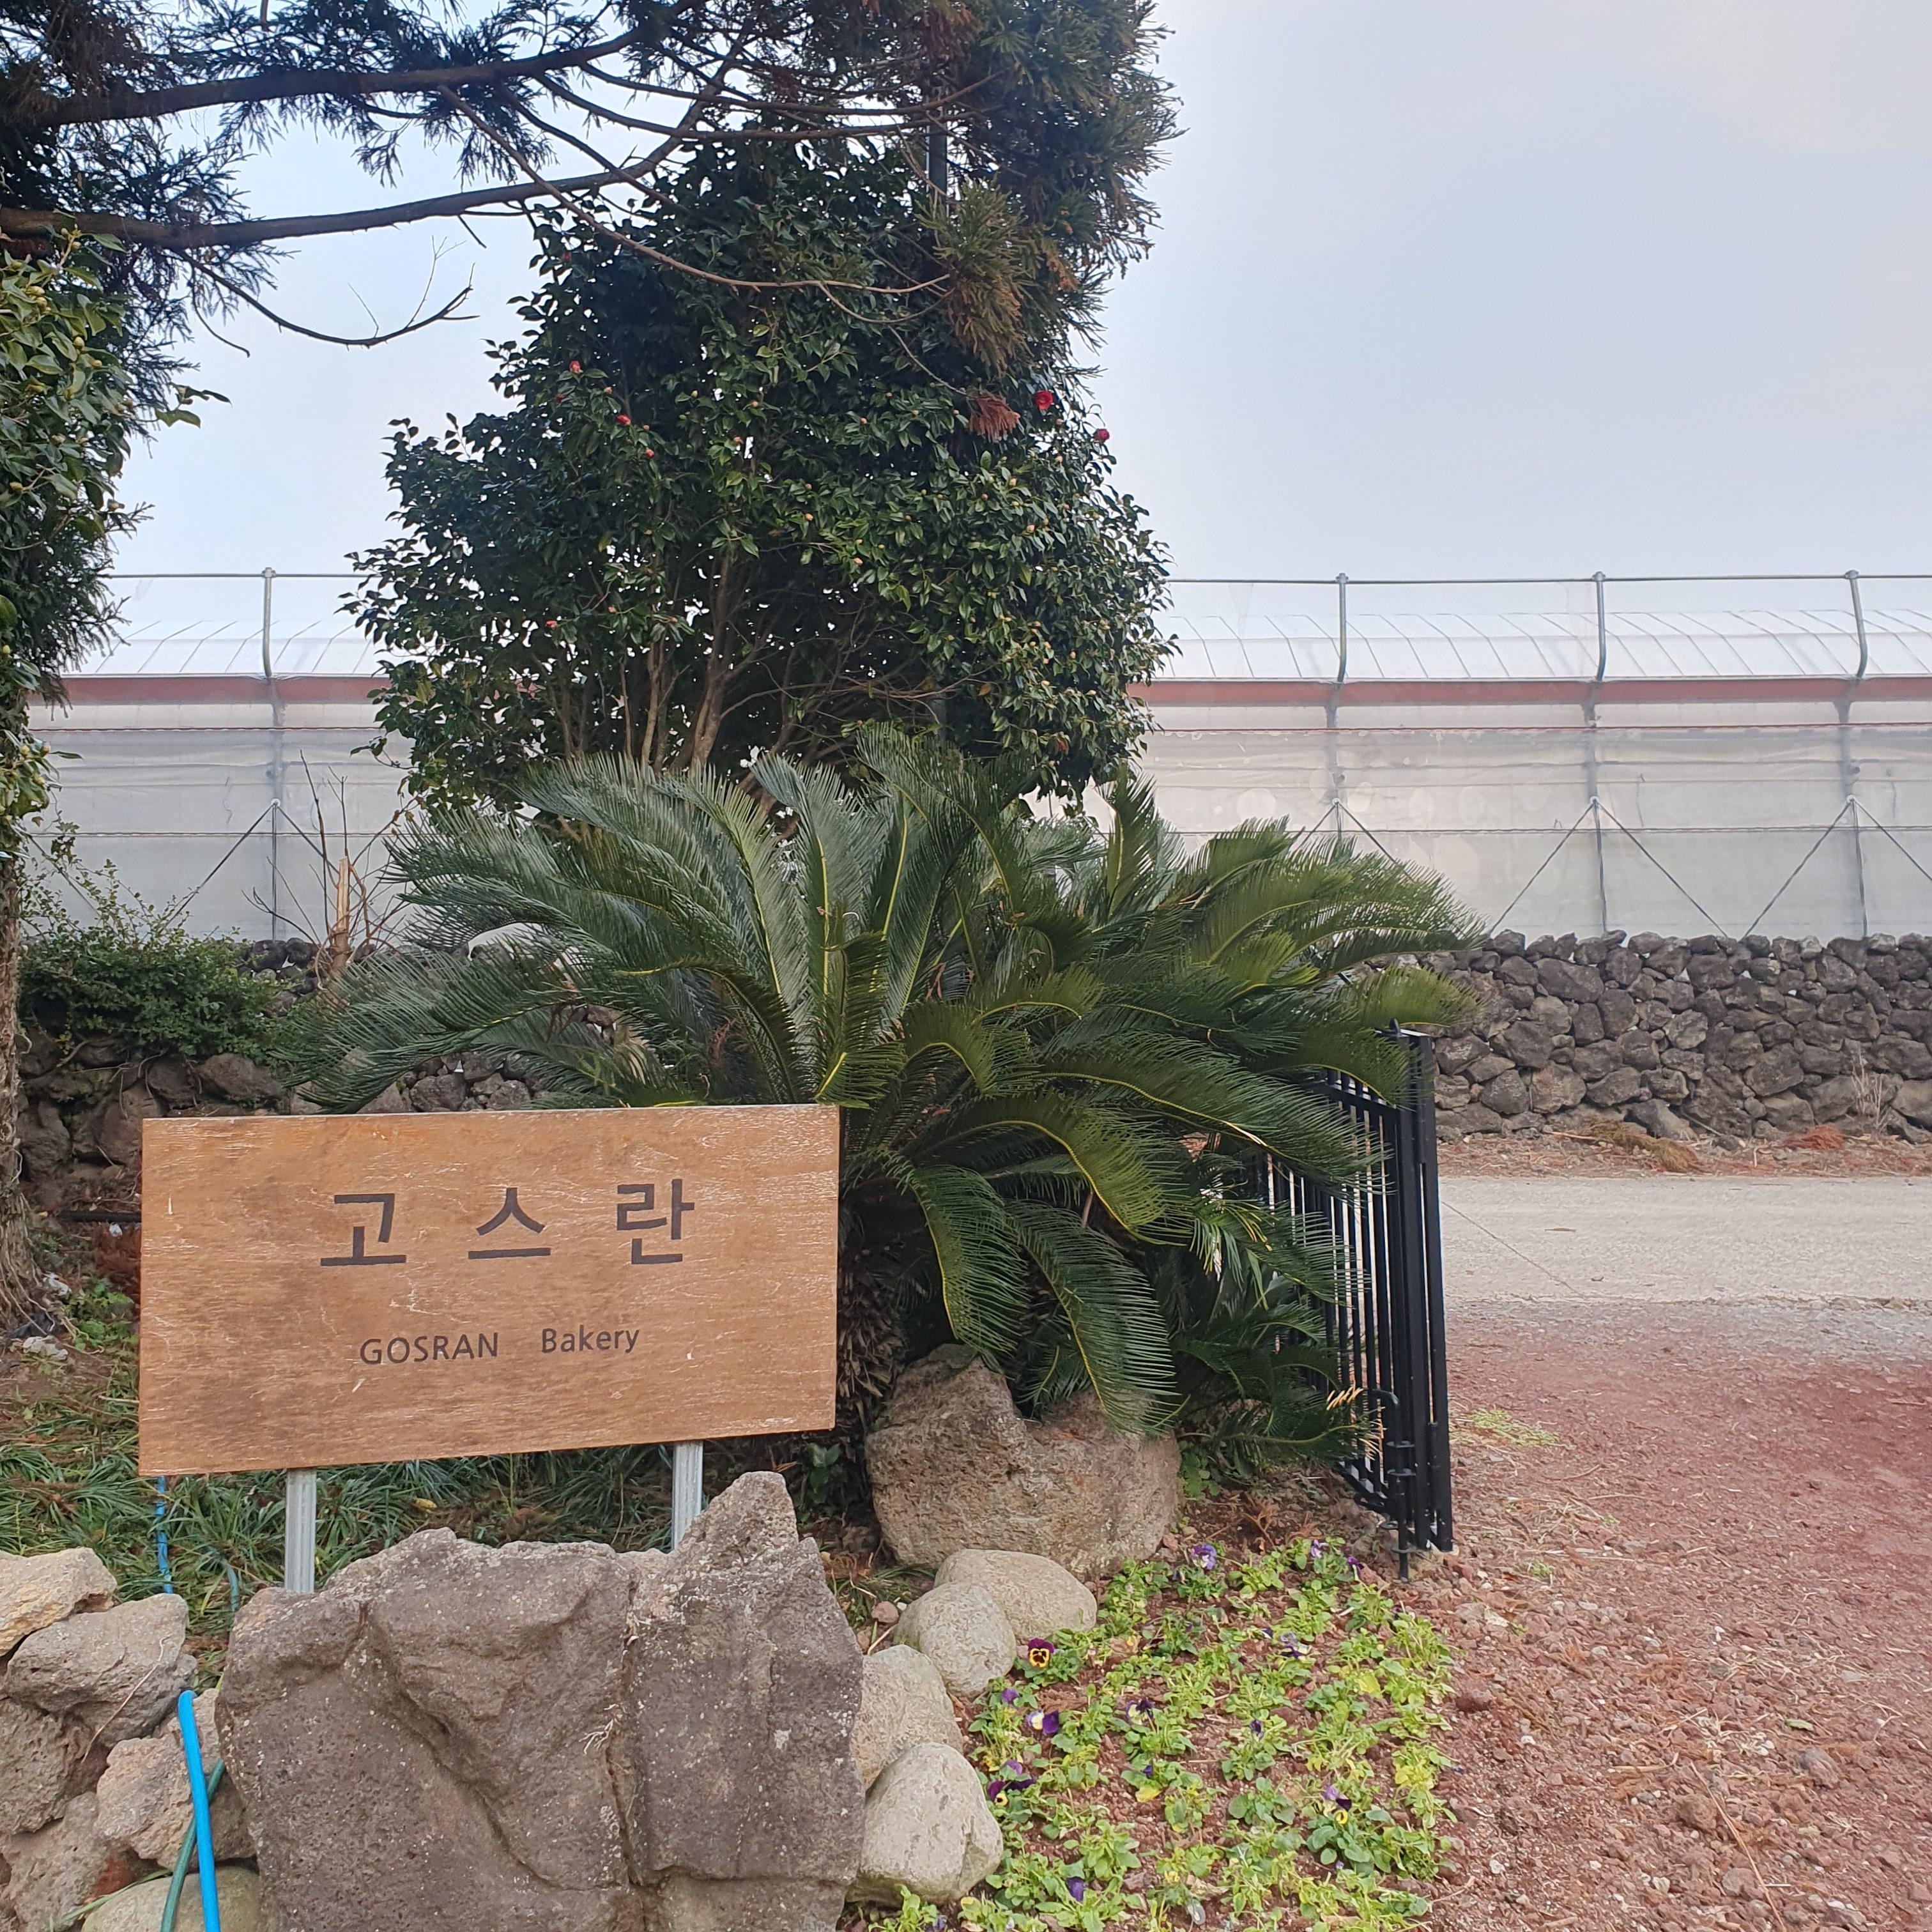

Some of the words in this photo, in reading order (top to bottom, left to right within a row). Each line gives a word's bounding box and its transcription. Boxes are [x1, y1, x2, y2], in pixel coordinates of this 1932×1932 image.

[320, 1179, 695, 1267] 고스란
[360, 1332, 499, 1365] GOSRAN
[541, 1324, 640, 1354] Bakery
